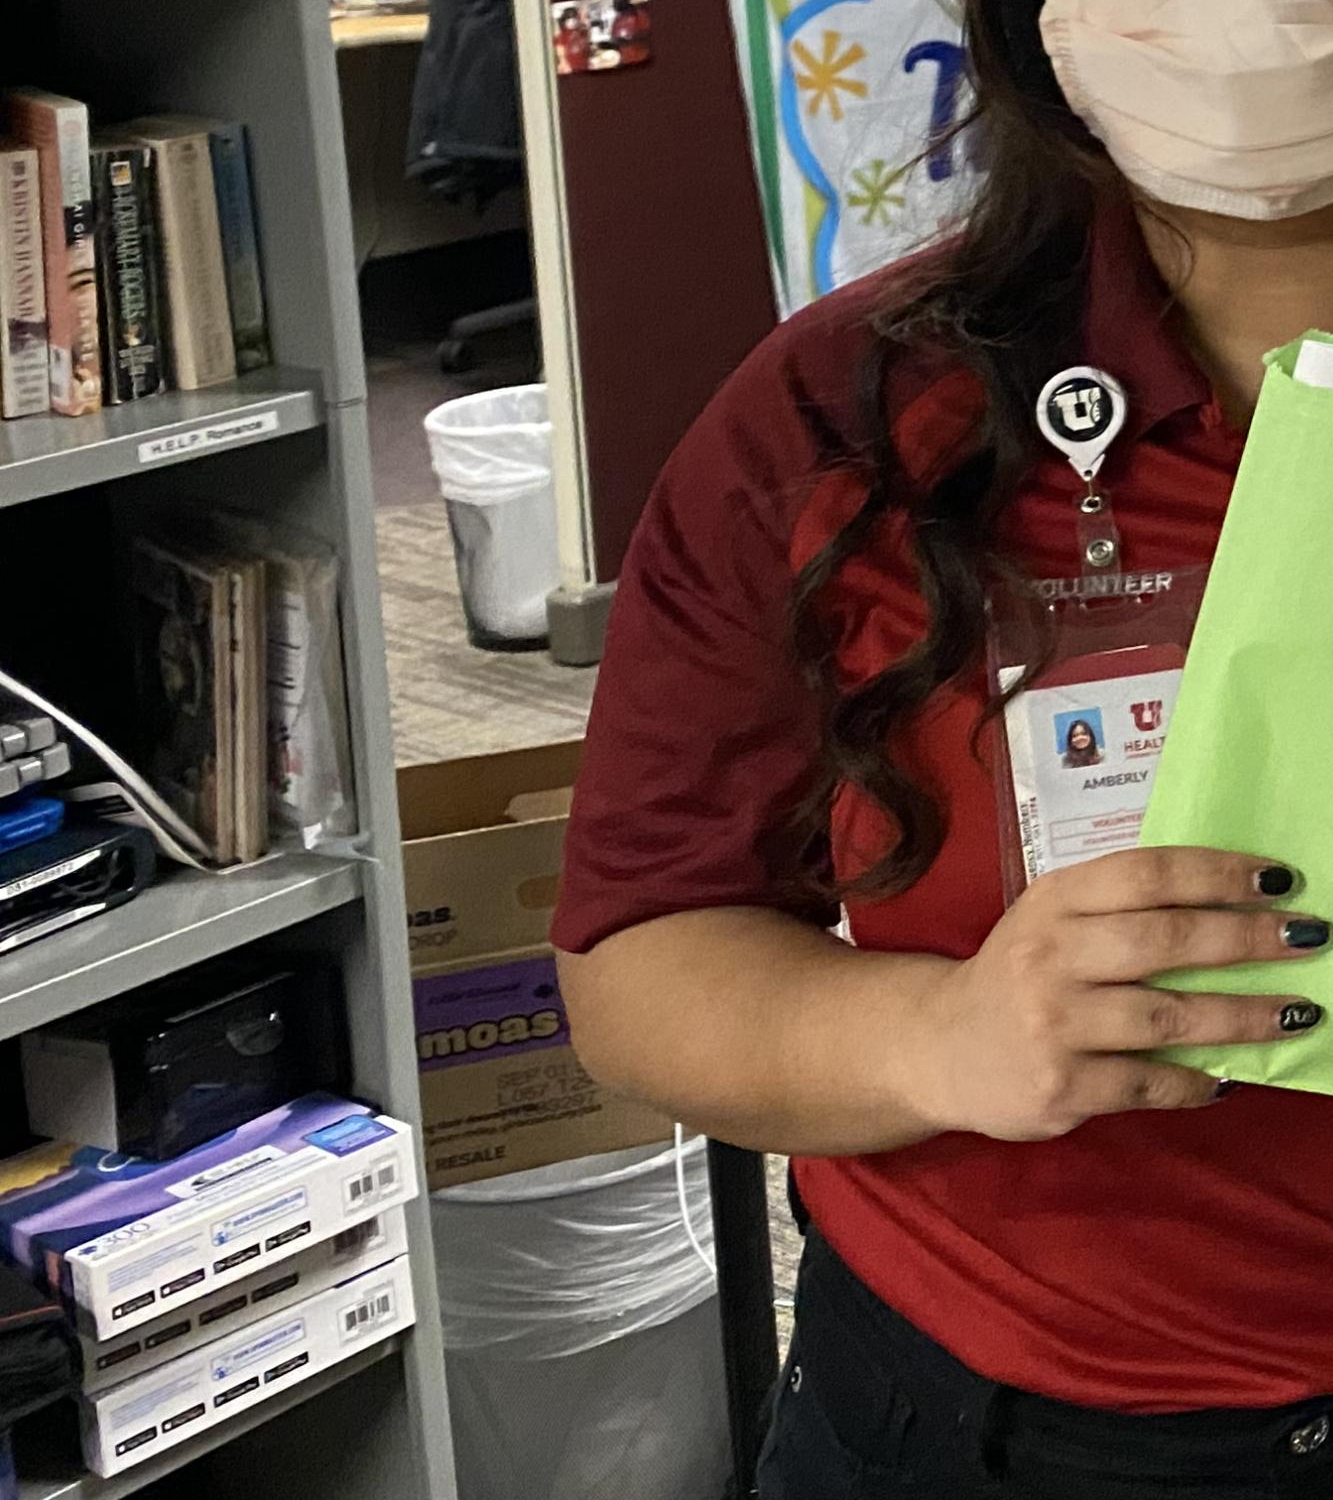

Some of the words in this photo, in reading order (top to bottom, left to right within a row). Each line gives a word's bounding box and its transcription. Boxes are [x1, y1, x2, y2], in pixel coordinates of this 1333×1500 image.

[206, 420, 263, 441] Romance
[1082, 770, 1149, 791] AMBERLY
[435, 1145, 506, 1171] RESALE
[101, 1222, 151, 1250] 300
